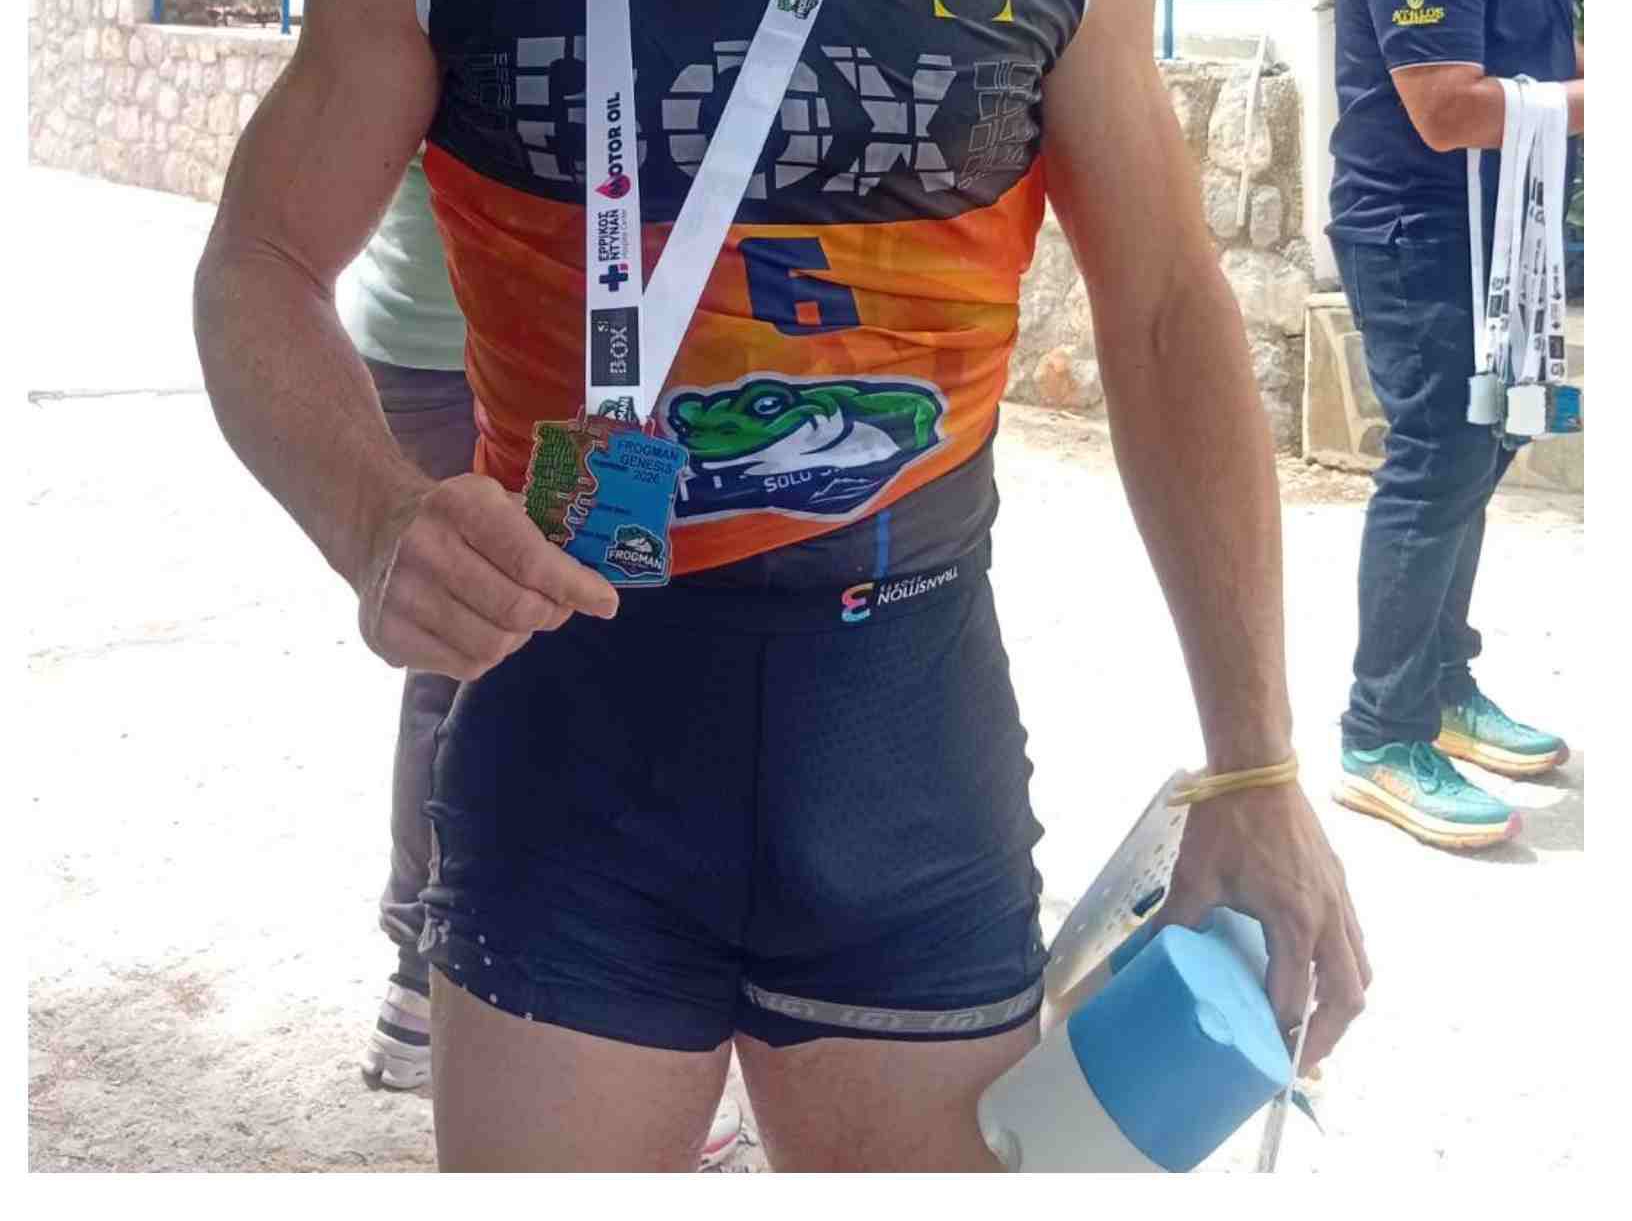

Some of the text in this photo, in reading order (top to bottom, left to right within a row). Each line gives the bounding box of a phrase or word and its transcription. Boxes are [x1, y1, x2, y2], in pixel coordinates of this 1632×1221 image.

[607, 91, 621, 122] OIL
[738, 236, 861, 337] 6
[609, 324, 628, 375] BOX
[617, 439, 679, 461] FROGMAN
[608, 548, 663, 570] FROGMAN
[876, 565, 960, 606] TRANSITION
